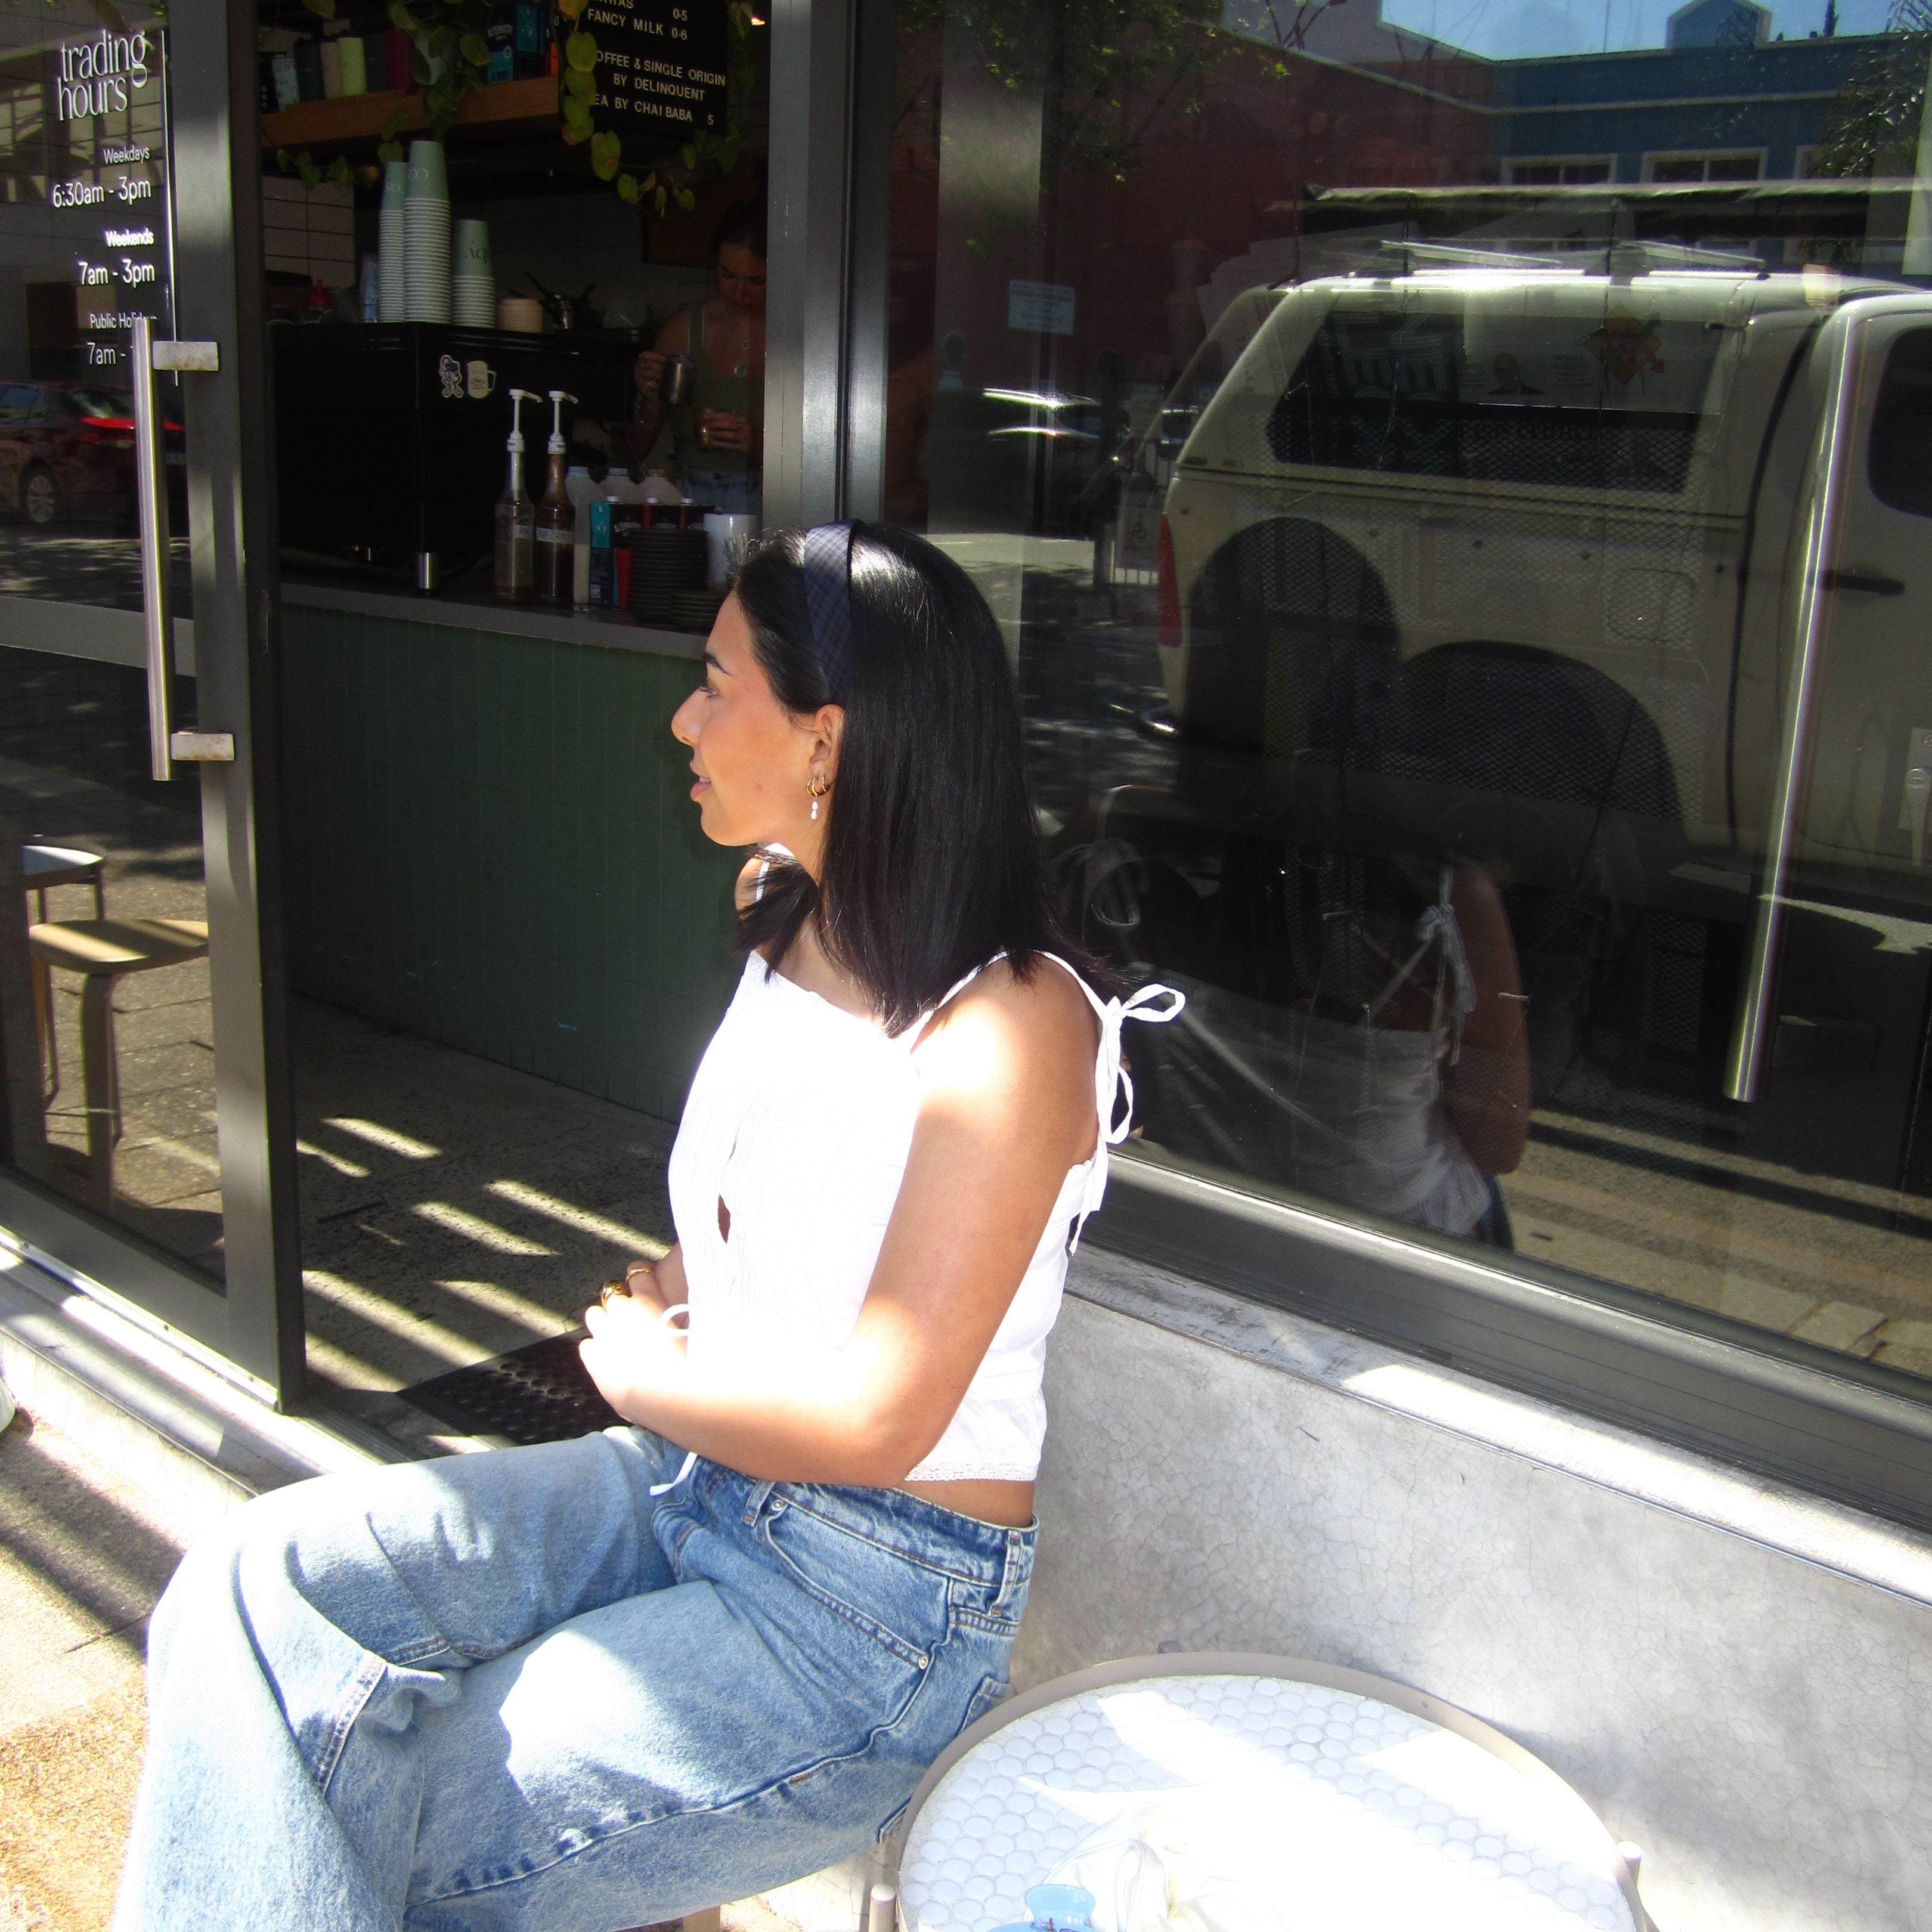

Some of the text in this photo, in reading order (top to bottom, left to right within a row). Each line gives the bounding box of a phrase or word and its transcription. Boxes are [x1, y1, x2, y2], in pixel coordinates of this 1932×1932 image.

[587, 8, 626, 27] FANCY
[633, 18, 664, 36] MILK
[61, 29, 148, 89] trading
[596, 50, 726, 86] OFFEE & SINGLE ORIGIN
[57, 75, 128, 121] hours
[613, 73, 705, 102] BY DELINQUENT
[595, 93, 609, 107] EA
[615, 97, 629, 110] BY
[708, 114, 714, 125] 5
[103, 145, 150, 165] Weekdays
[52, 181, 104, 208] 6:30am
[118, 177, 151, 206] 3pm
[106, 228, 154, 247] Weekends
[78, 261, 109, 286] 7am
[122, 258, 155, 287] 3pm
[90, 313, 117, 330] Public
[86, 342, 116, 365] 7am
